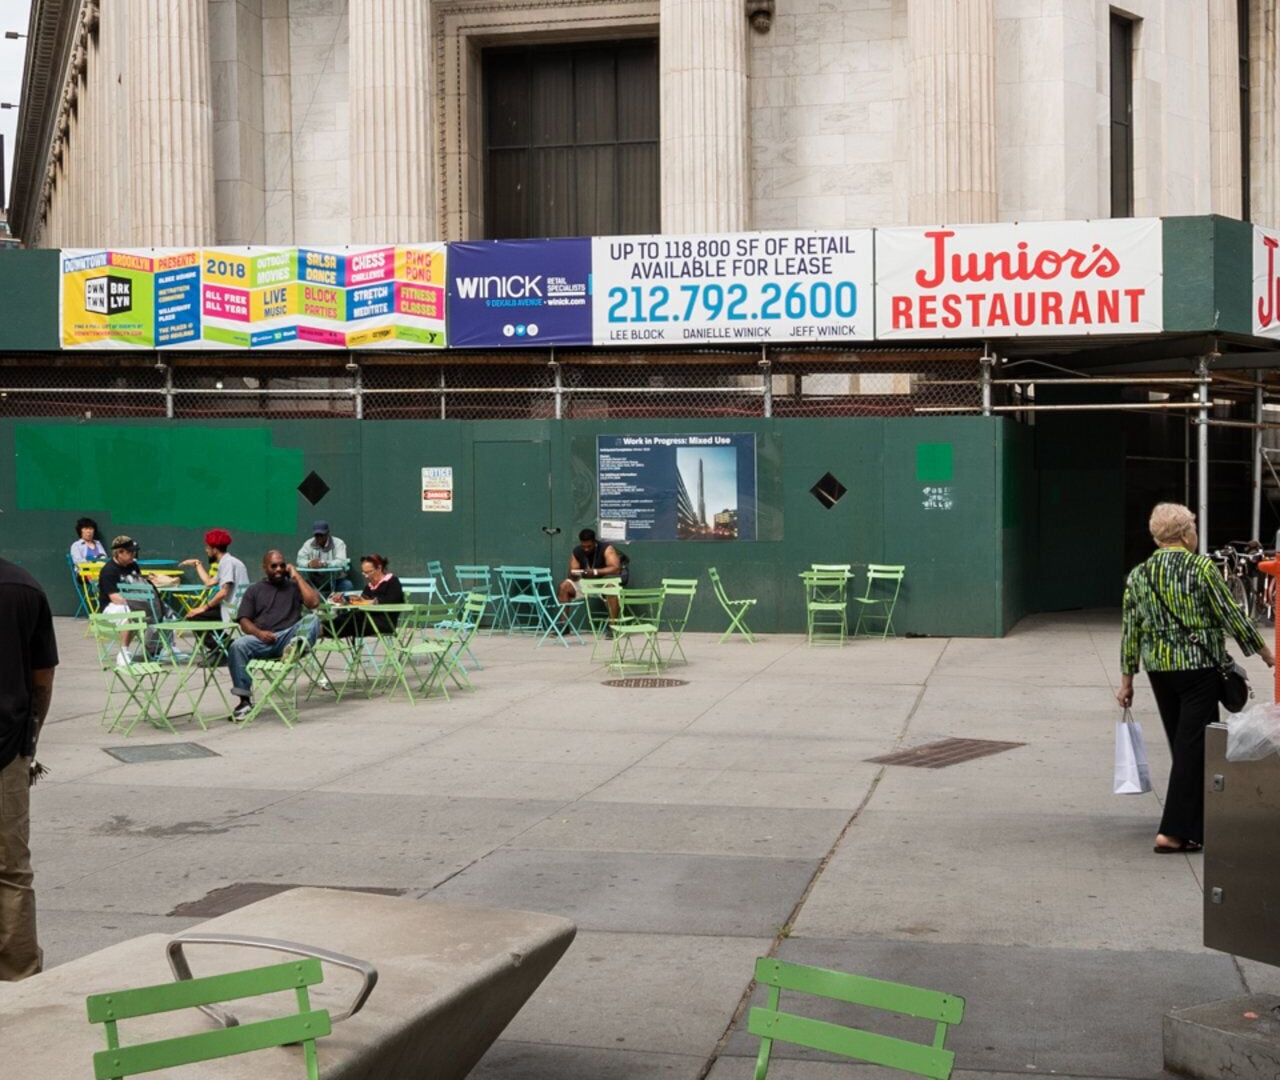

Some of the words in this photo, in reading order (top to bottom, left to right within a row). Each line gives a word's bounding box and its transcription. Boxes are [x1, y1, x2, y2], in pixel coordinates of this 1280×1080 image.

[610, 243, 636, 261] UP
[640, 242, 659, 260] TO
[664, 239, 731, 262] 118,800
[736, 238, 761, 257] SF
[765, 237, 789, 256] OF
[794, 236, 855, 255] RETAIL
[66, 254, 107, 272] DOWNTOWN
[112, 253, 150, 271] BROOKLYN
[158, 253, 195, 270] PRESENTS
[257, 253, 290, 269] OUTDOOR
[306, 252, 336, 269] SALSA
[352, 252, 385, 271] CHESS
[406, 251, 432, 267] PING
[915, 231, 1121, 289] Junior's
[207, 259, 246, 278] 2018
[257, 267, 290, 284] MOVIES
[406, 267, 432, 282] PONG
[631, 260, 726, 279] AVAILABLE
[732, 258, 768, 277] FOR
[774, 256, 832, 276] LEASE
[306, 268, 336, 284] DANCE
[351, 269, 385, 283] CHALLENGE
[547, 277, 567, 285] RETAIL
[110, 283, 130, 294] BRK
[263, 288, 287, 305] LIVE
[304, 287, 337, 304] BLOCK
[353, 286, 388, 302] STRETCH
[401, 286, 436, 303] FITNESS
[547, 284, 586, 293] SPECIALISTS
[110, 296, 130, 308] LYN
[205, 291, 222, 300] ALL
[225, 293, 247, 304] FREE
[548, 298, 586, 306] winick.com
[607, 281, 857, 323] 212.792.2600
[205, 301, 222, 310] ALL
[225, 303, 248, 315] YEAR
[264, 305, 287, 317] MUSIC
[304, 304, 337, 319] PARTIES
[353, 303, 388, 318] MEDITATE
[401, 300, 437, 316] CLASSES
[891, 288, 1146, 329] RESTAURANT
[610, 328, 629, 340] LEE
[633, 327, 665, 340] BLOCK
[683, 326, 728, 339] DANIELLE
[731, 325, 771, 338] WINICK
[789, 325, 813, 338] JEFF
[816, 325, 856, 337] WINICK
[623, 437, 643, 445] Work
[644, 437, 652, 445] in
[654, 437, 687, 446] Progress:
[689, 436, 713, 445] Mixed
[714, 436, 731, 445] Use
